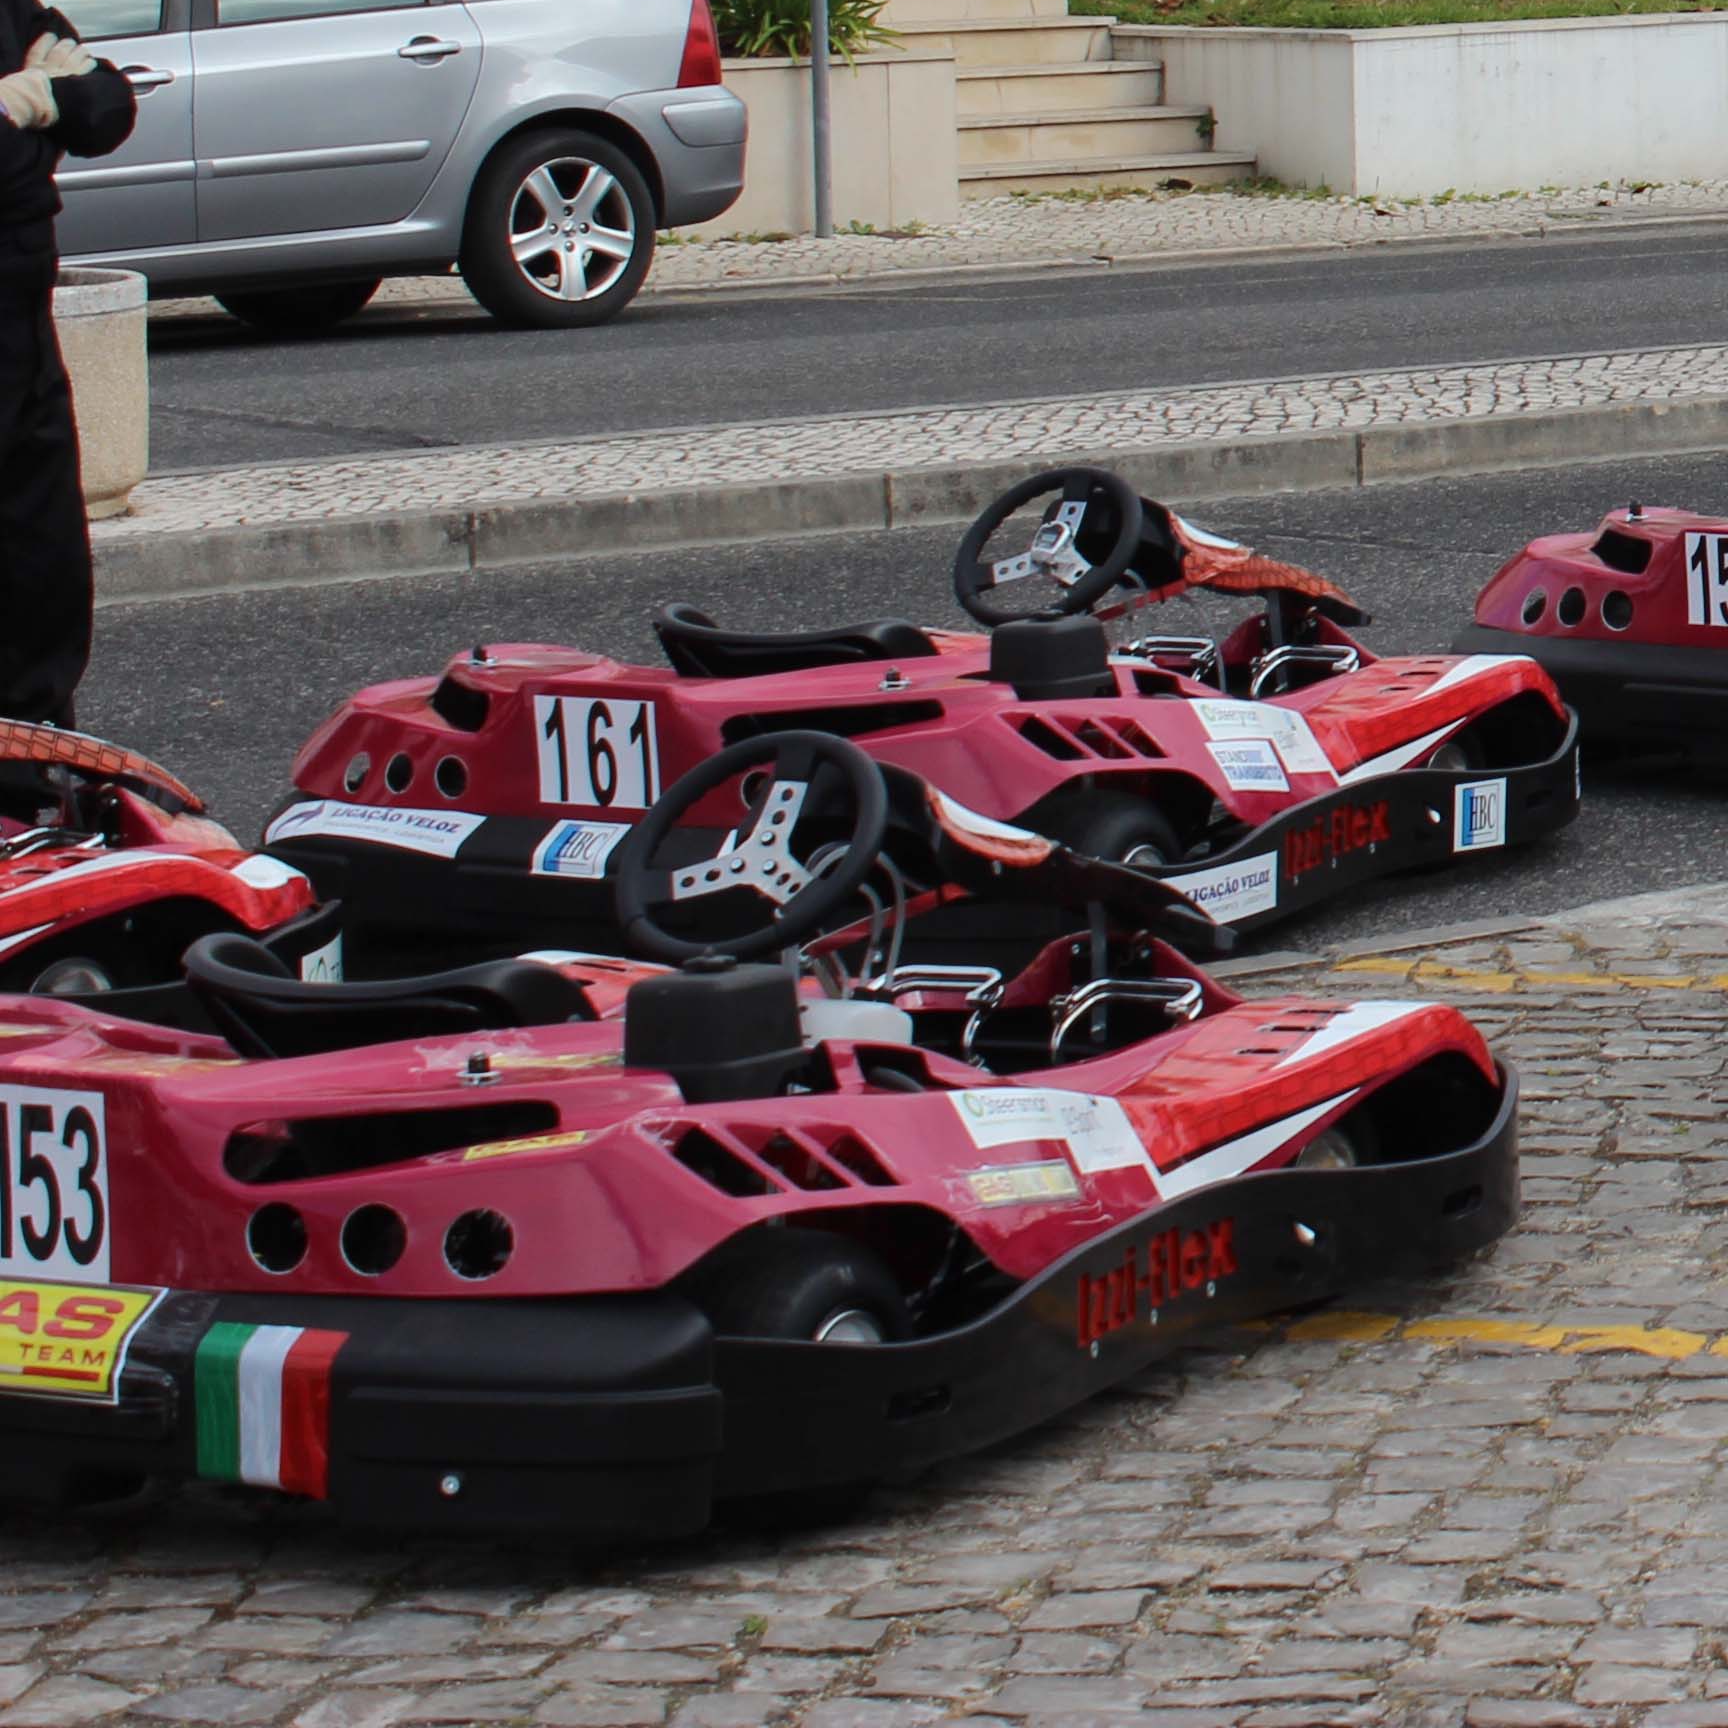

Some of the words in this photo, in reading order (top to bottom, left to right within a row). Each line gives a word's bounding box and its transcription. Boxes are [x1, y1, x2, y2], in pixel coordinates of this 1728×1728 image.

[545, 698, 654, 807] 161
[404, 817, 462, 834] VELOZ
[1469, 794, 1497, 833] HBC
[0, 1290, 125, 1340] AS
[19, 1343, 107, 1367] TEAM
